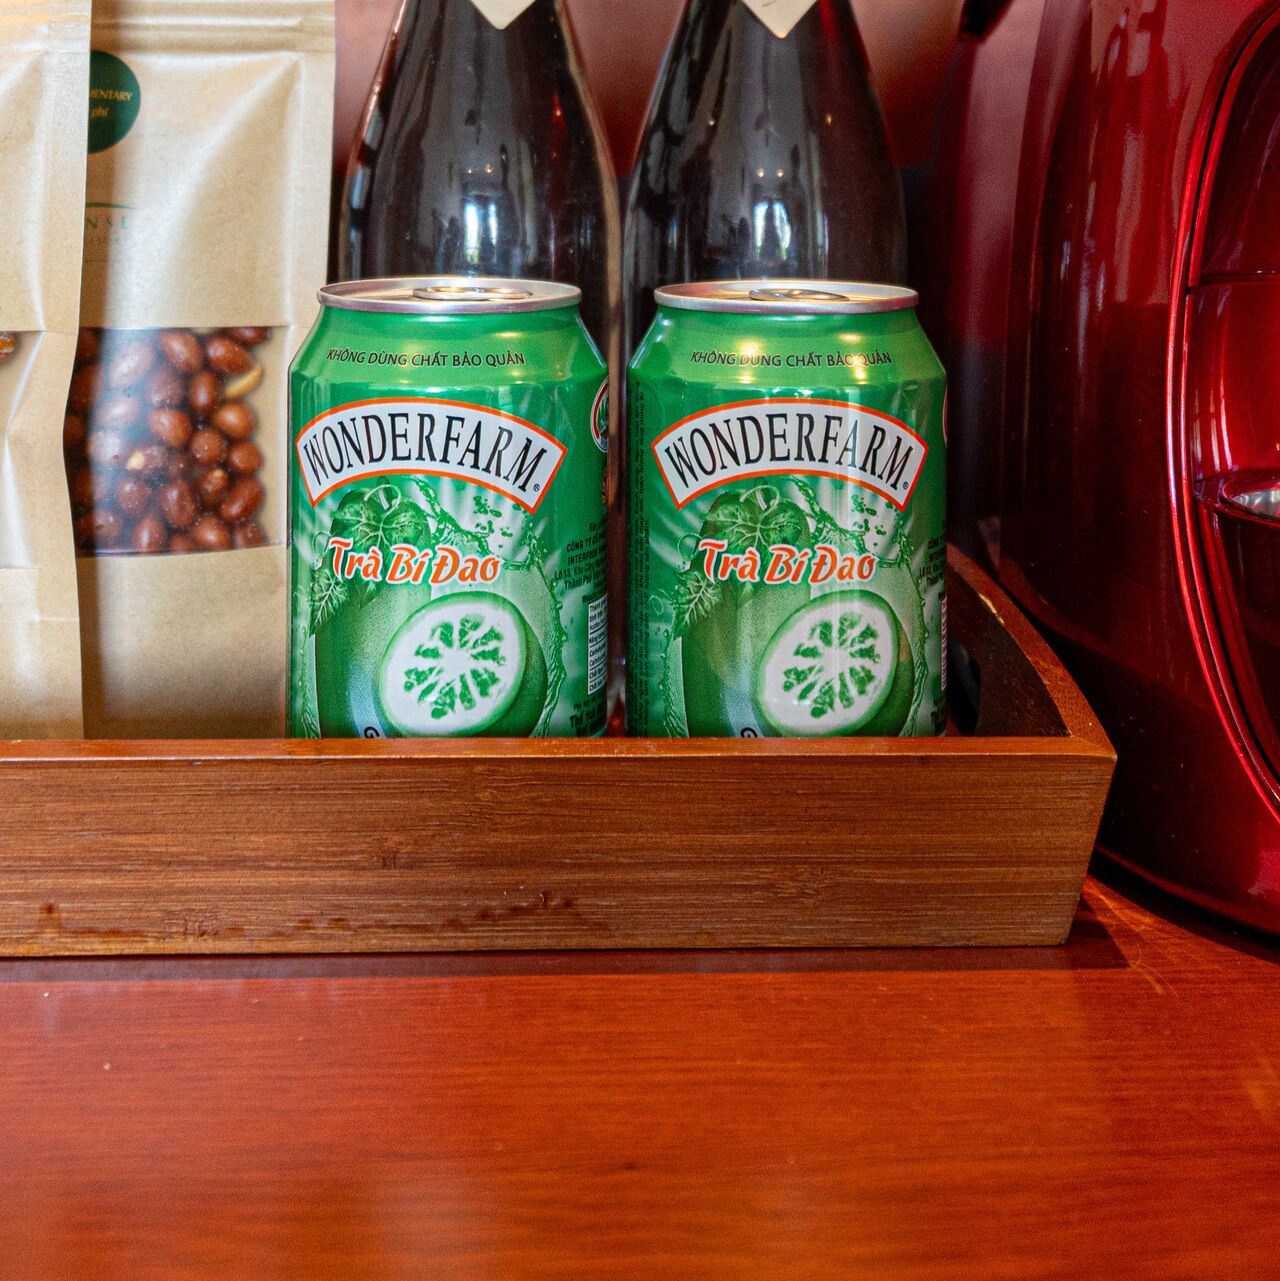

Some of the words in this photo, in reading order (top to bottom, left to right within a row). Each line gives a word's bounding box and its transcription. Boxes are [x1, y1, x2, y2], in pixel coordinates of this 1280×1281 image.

[326, 348, 366, 363] KHÔNG
[368, 350, 408, 366] DÙNG
[411, 350, 448, 367] CHẤT
[452, 351, 482, 367] BẢO
[690, 350, 736, 365] KHÔNG
[785, 351, 822, 367] CHẤT
[303, 412, 548, 493] WONDERFARM
[664, 412, 913, 491] WONDERFARM
[329, 539, 380, 580] Trà
[387, 546, 431, 583] Bí
[431, 546, 501, 584] Đao
[699, 540, 758, 581] Trà
[765, 546, 810, 583] Bí
[810, 545, 876, 584] Đao
